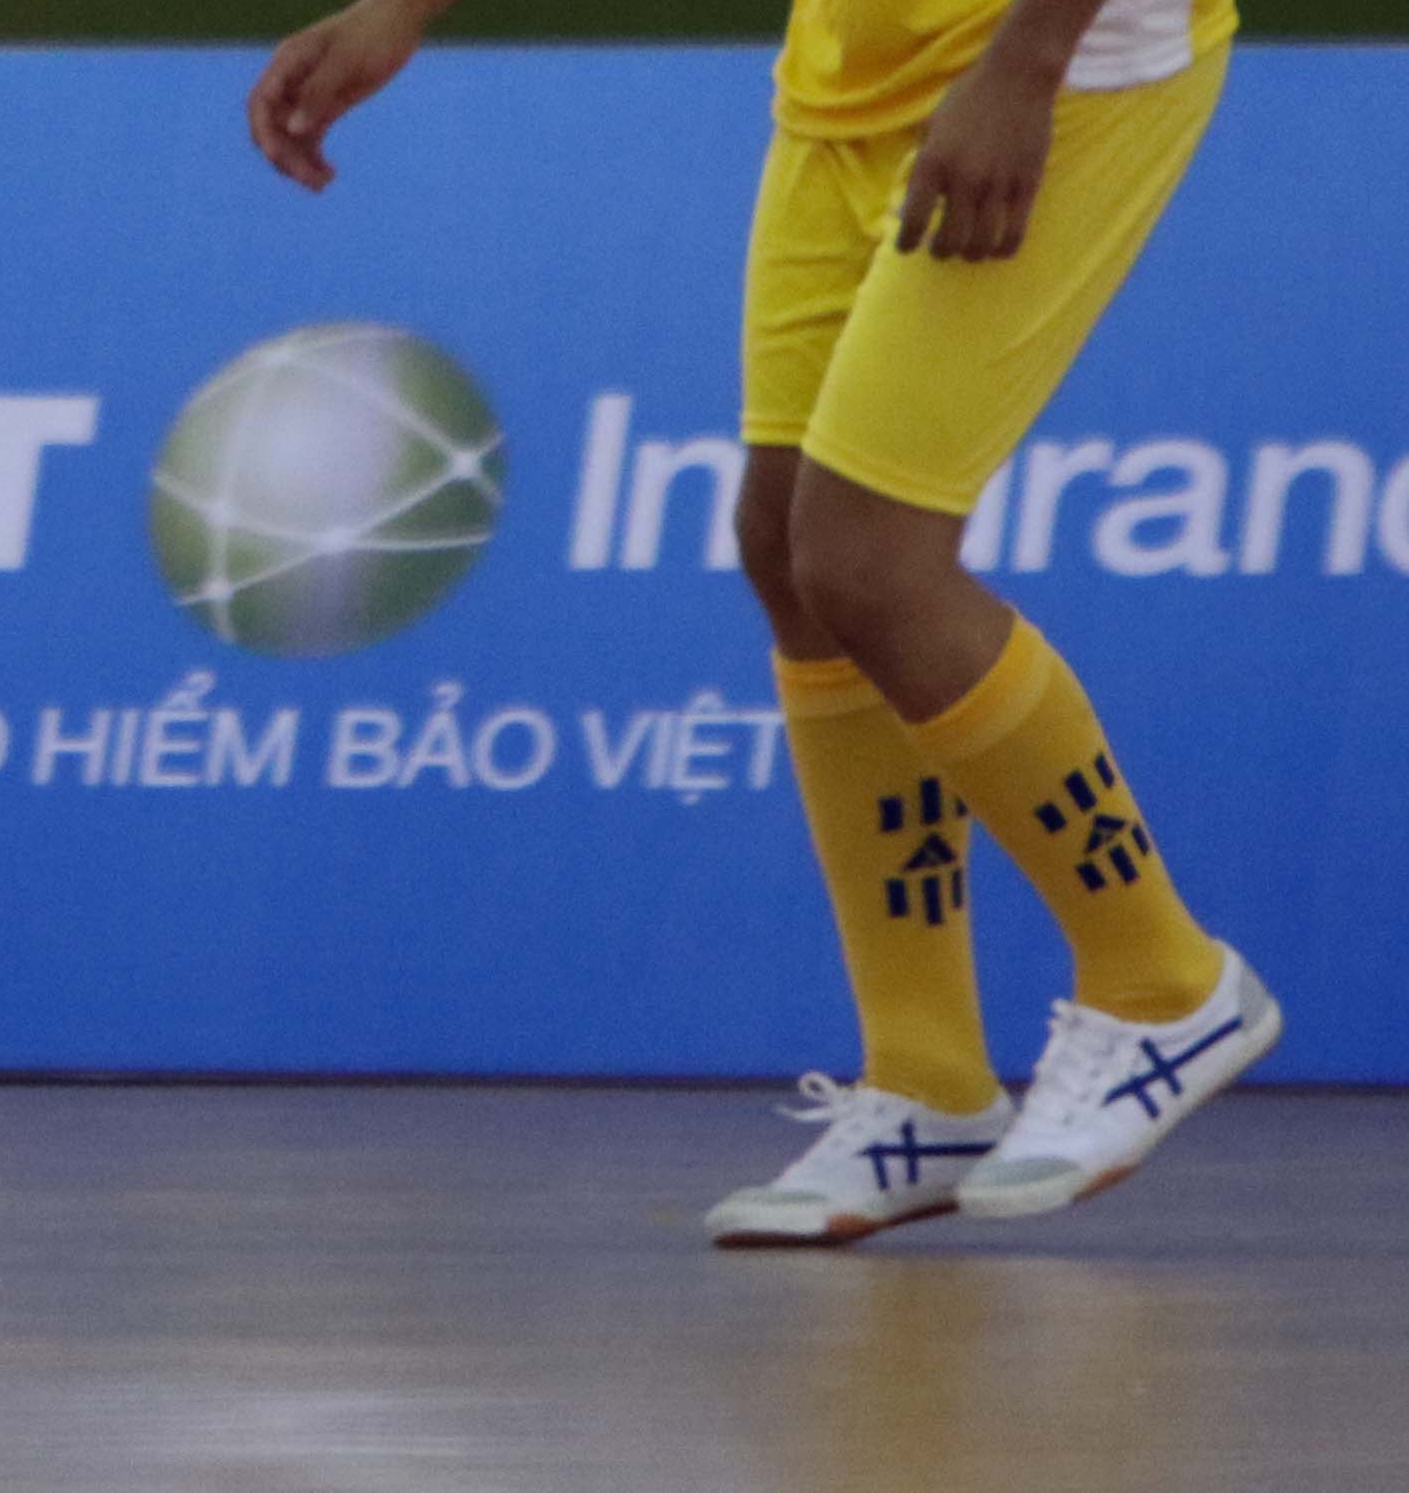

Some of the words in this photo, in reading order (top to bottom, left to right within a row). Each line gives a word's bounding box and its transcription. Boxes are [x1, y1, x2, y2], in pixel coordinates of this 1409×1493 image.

[31, 669, 301, 788] HIỂM
[327, 678, 556, 791] BẢO
[581, 686, 788, 806] VIỆT
